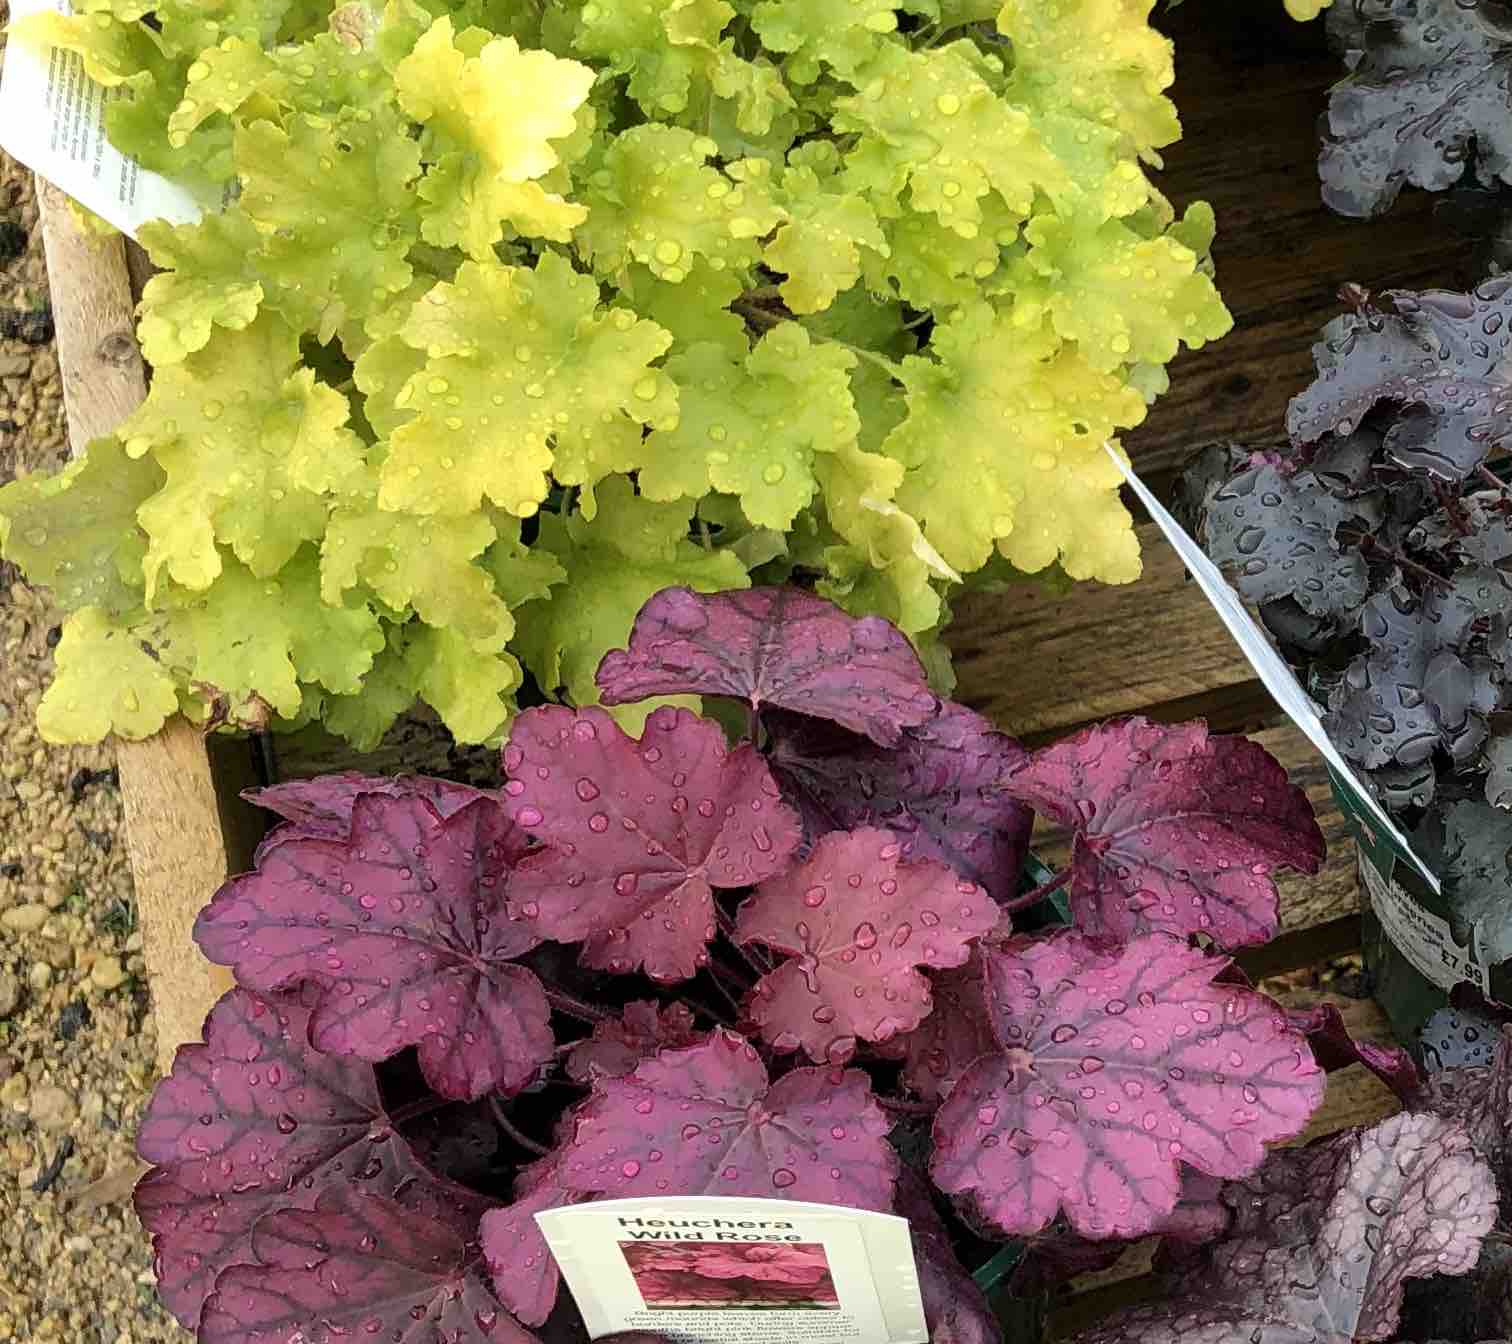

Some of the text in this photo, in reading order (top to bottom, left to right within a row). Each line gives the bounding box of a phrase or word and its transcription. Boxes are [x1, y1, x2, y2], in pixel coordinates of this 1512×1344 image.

[617, 1217, 794, 1229] Heuchera
[627, 1230, 803, 1242] Wild Rose
